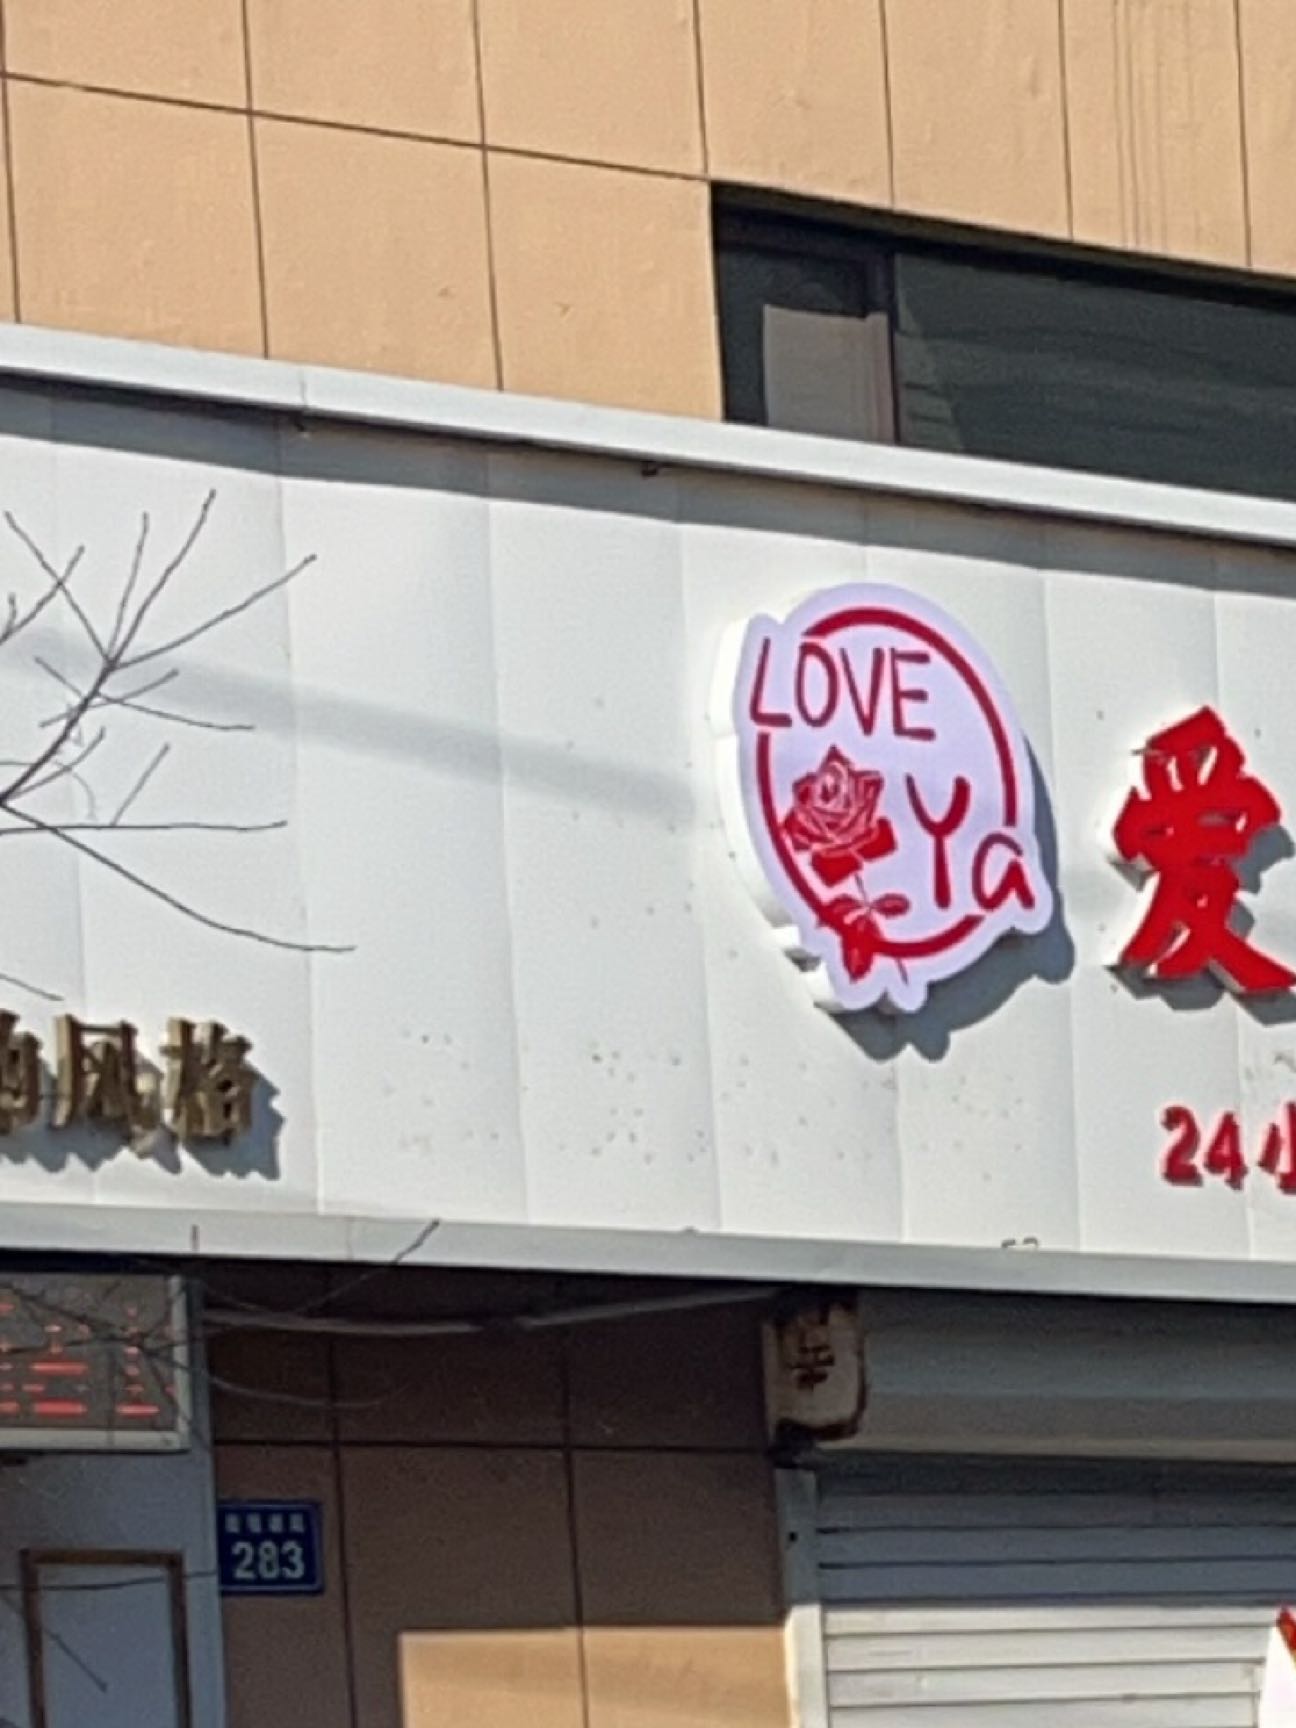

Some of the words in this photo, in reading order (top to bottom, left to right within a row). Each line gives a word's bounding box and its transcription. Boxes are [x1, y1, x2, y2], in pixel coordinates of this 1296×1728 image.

[750, 637, 936, 742] LOVE
[906, 773, 1036, 910] Ya
[232, 1541, 305, 1579] 283
